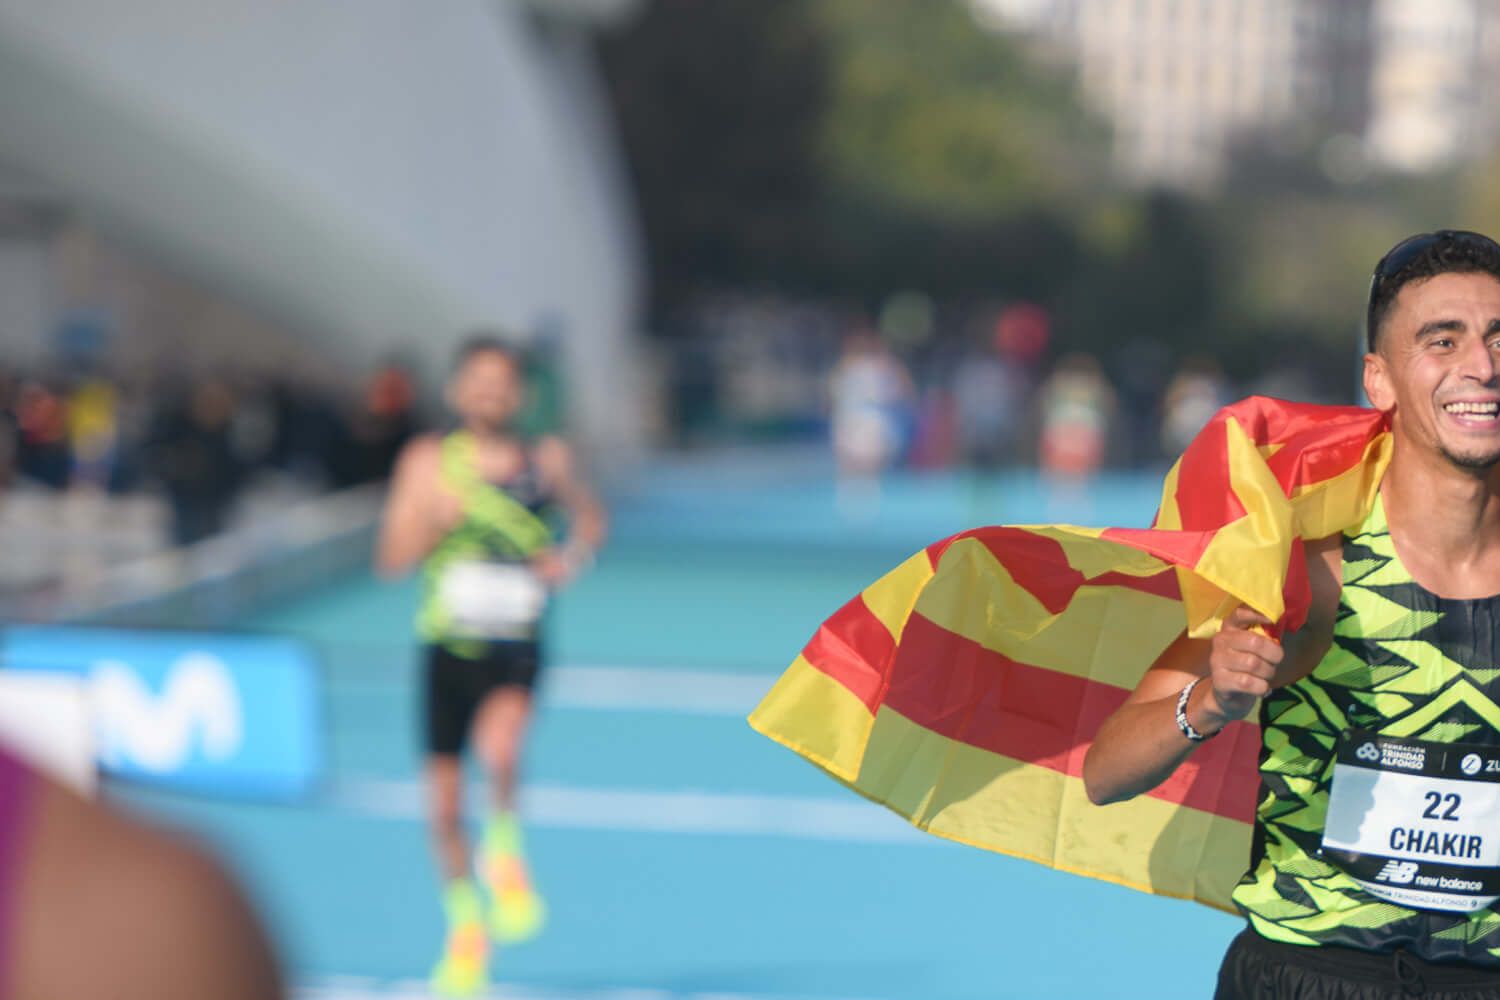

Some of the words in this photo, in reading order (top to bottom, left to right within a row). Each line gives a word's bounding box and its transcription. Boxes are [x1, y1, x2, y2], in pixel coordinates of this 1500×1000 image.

[1380, 757, 1424, 770] ALFONSO
[1382, 749, 1425, 762] TRINIDAD
[1422, 791, 1462, 821] 22
[1389, 827, 1483, 859] CHAKIR
[1415, 875, 1440, 887] new
[1439, 876, 1483, 891] balance
